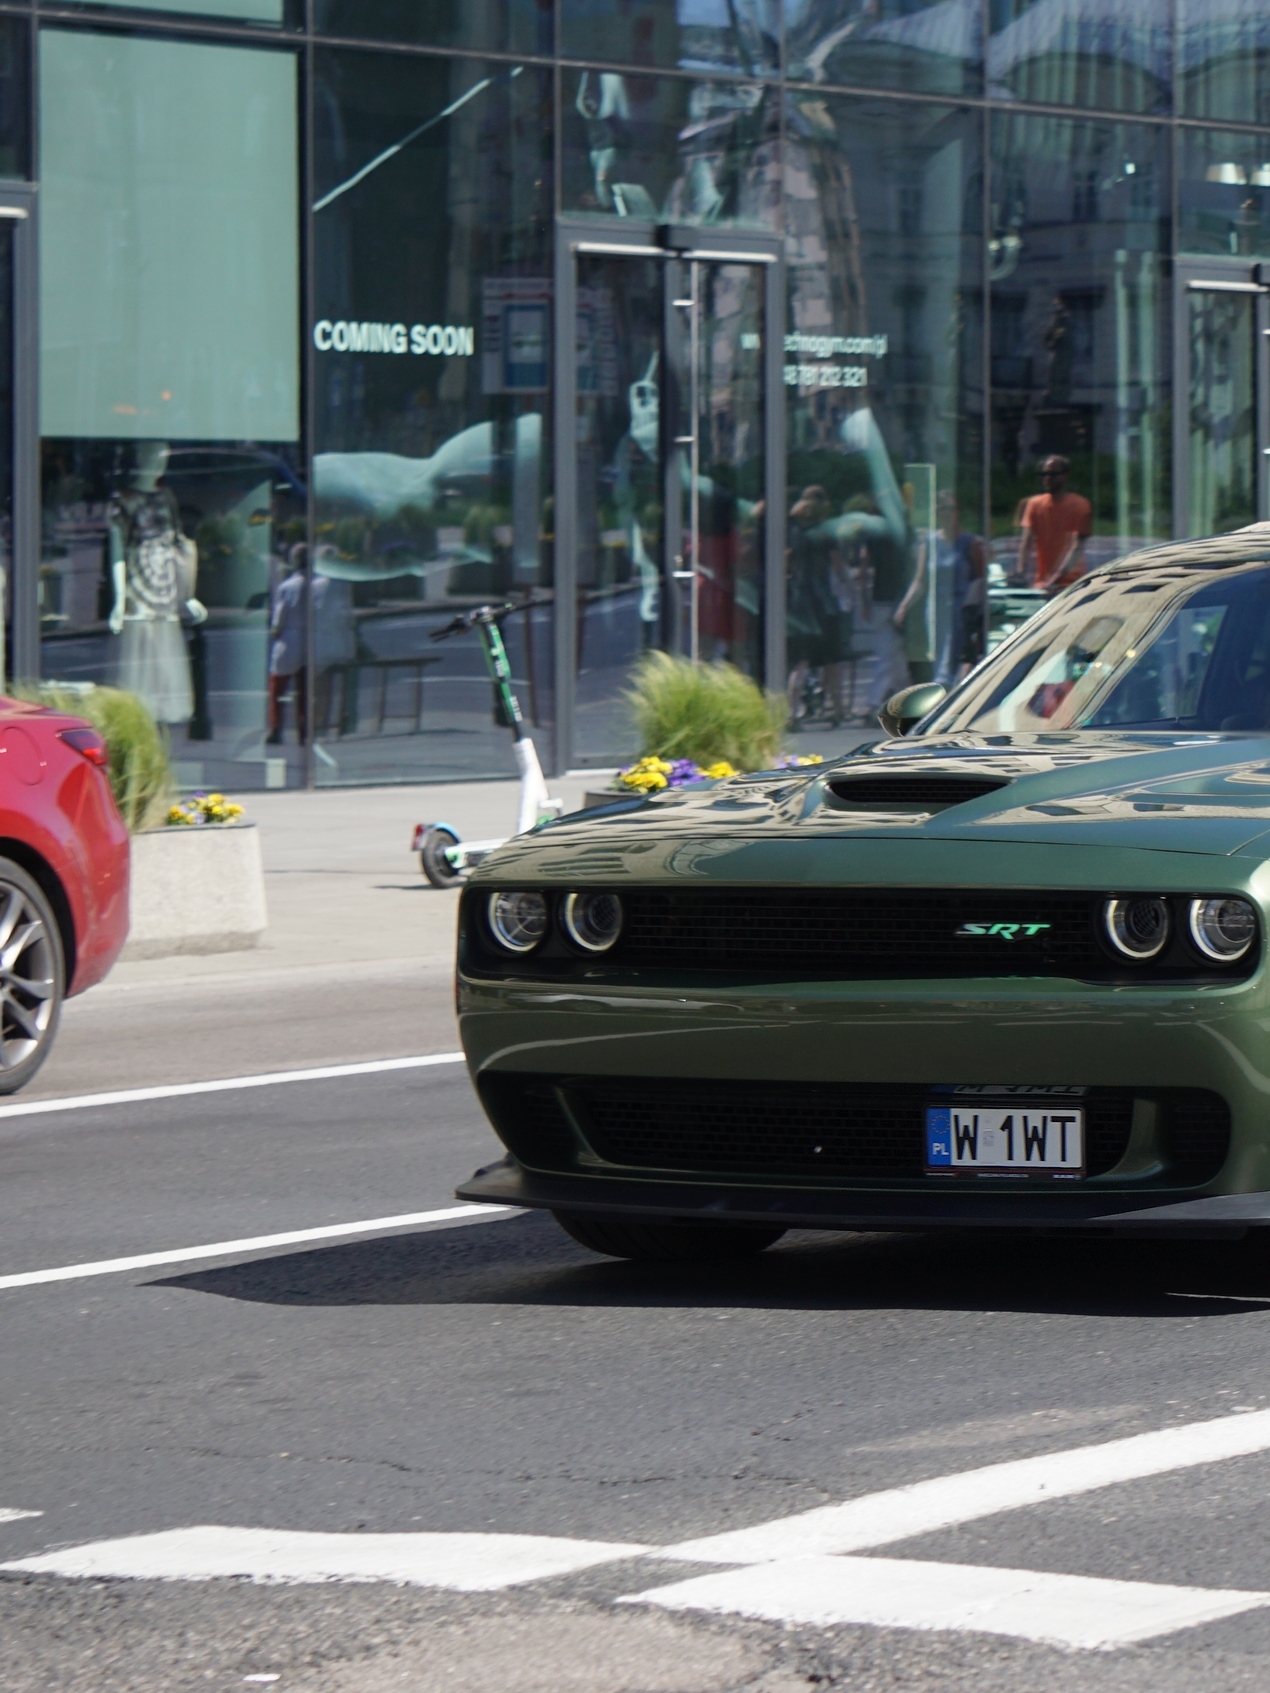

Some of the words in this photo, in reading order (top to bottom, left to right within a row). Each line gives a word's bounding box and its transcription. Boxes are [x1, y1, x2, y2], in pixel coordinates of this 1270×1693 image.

[313, 320, 408, 354] COMING
[410, 324, 474, 356] SOON
[842, 367, 867, 388] 321
[955, 923, 1051, 940] SRT
[953, 1115, 980, 1161] W
[999, 1115, 1076, 1162] 1WT
[932, 1143, 950, 1156] PL
